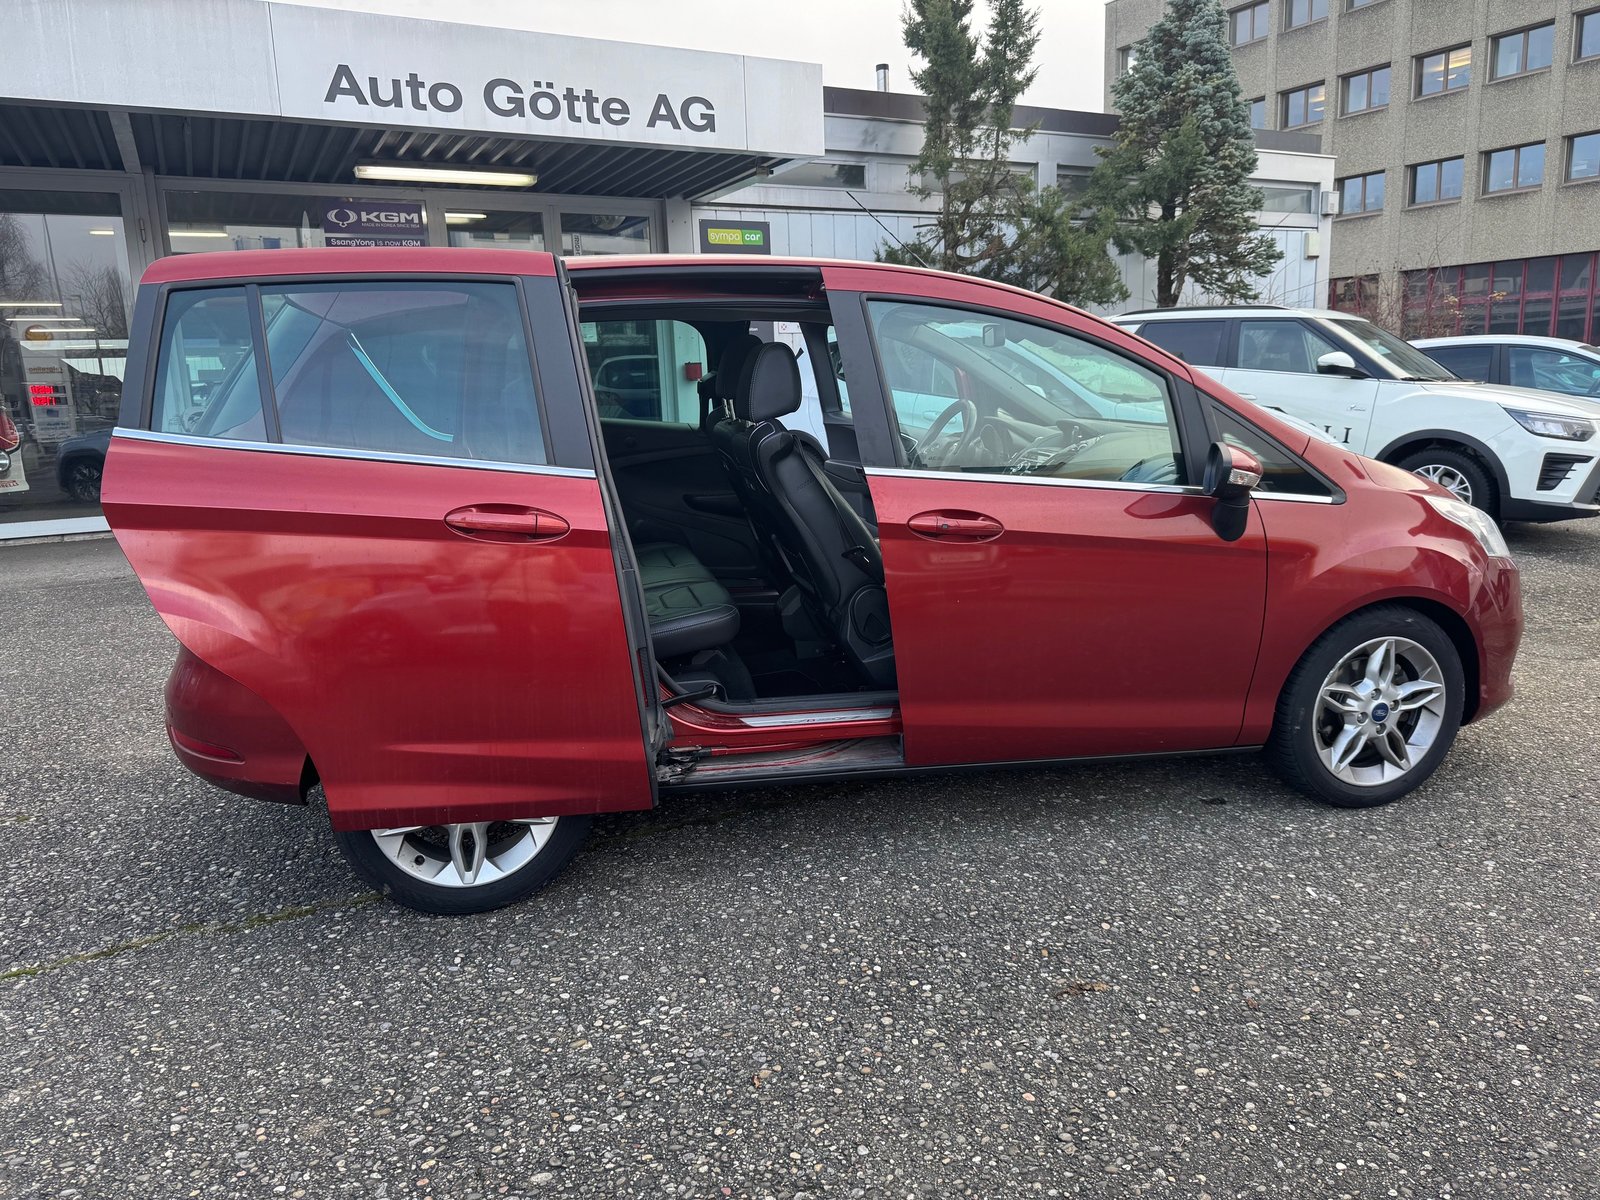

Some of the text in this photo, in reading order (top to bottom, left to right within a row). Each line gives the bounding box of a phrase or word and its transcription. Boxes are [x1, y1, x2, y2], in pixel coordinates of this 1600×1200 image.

[323, 63, 717, 133] Auto Götte AG
[360, 211, 419, 224] KGM
[330, 238, 375, 247] SsangYong
[402, 239, 421, 247] KGM
[710, 232, 761, 243] sympa car
